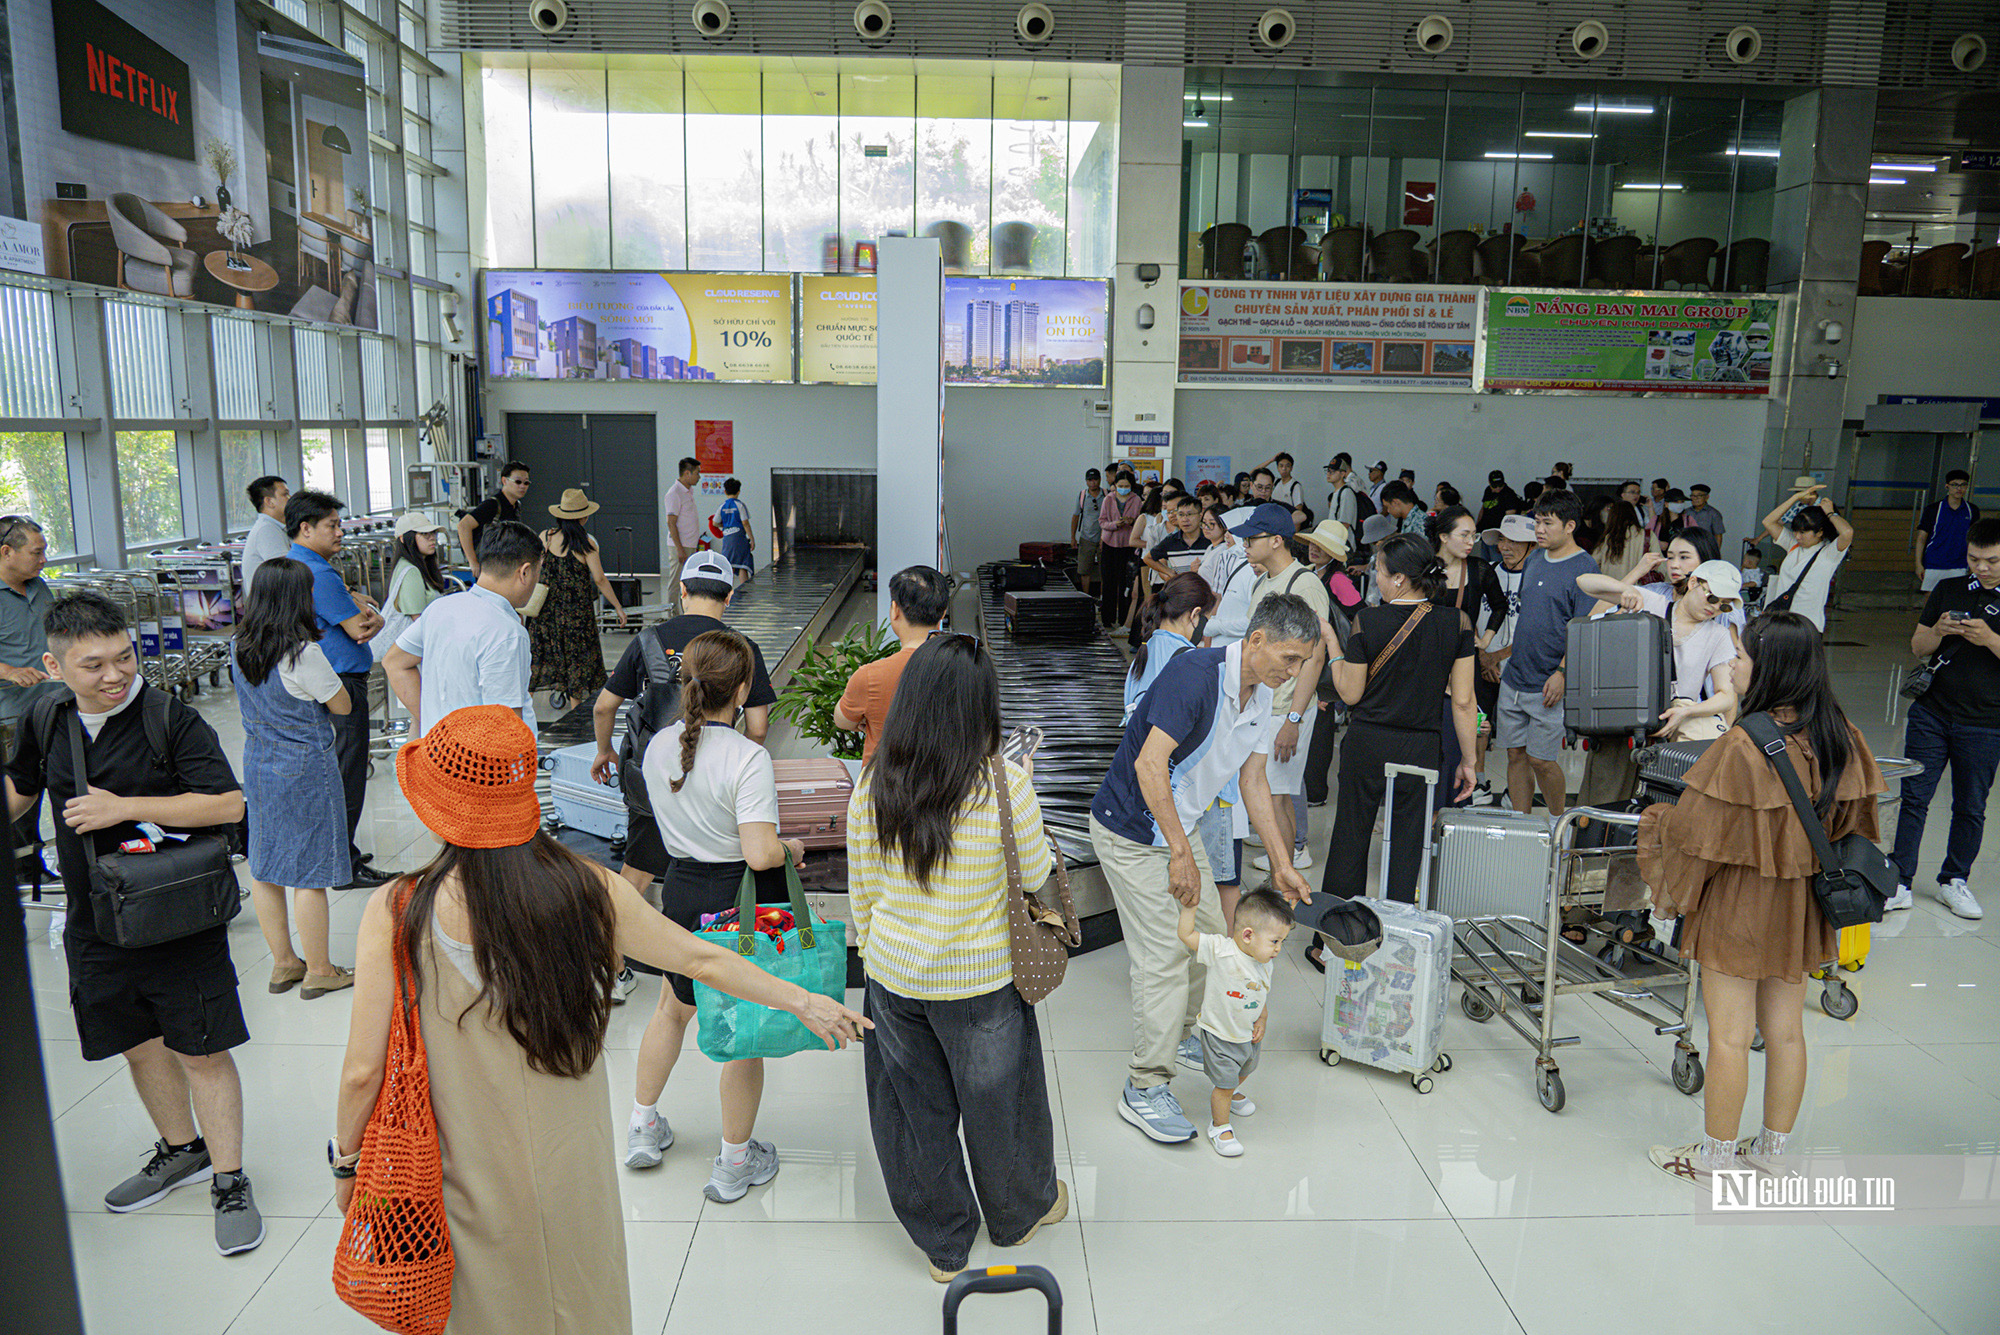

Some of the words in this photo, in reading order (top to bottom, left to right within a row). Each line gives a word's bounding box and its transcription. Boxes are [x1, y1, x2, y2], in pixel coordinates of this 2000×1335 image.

[86, 42, 179, 125] NETFLIX
[13, 243, 40, 257] AMOR
[705, 289, 736, 298] CLOUD
[737, 290, 780, 298] RESERVE
[820, 291, 860, 301] CLOUD
[1214, 288, 1246, 299] CÔNG
[1250, 290, 1263, 299] TY
[1266, 290, 1297, 300] TNHH
[1300, 289, 1322, 302] VẬT
[1325, 290, 1350, 303] LIỆU
[1354, 290, 1376, 301] XÂY
[1380, 291, 1412, 304] DỰNG
[1415, 293, 1434, 303] GIA
[1438, 292, 1476, 304] THÀNH
[568, 301, 594, 310] BIỂU
[596, 302, 634, 312] TƯỢNG
[1234, 302, 1280, 315] CHUYÊN
[1284, 302, 1308, 316] SẢN
[1347, 304, 1379, 316] PHÂN
[1382, 304, 1410, 317] PHỐI
[1413, 304, 1424, 318] SỈ
[1428, 308, 1437, 318] &
[1440, 305, 1454, 318] LẺ
[1534, 296, 1590, 315] NẮNG
[1594, 304, 1636, 316] BAN
[1640, 304, 1678, 317] MAI
[1684, 306, 1748, 318] GROUP
[600, 314, 631, 324] SỐNG
[633, 315, 654, 324] MỚI
[713, 318, 724, 326] SỞ
[726, 318, 744, 326] HỮU
[746, 317, 759, 326] CHỈ
[1046, 315, 1091, 324] LIVING
[1218, 318, 1238, 327] GẠCH
[1260, 319, 1280, 328] GẠCH
[1286, 317, 1294, 326] LỖ
[1304, 319, 1324, 328] GẠCH
[1324, 319, 1350, 328] KHÔNG
[1379, 318, 1394, 328] ỐNG
[1396, 320, 1417, 328] CỐNG
[1427, 320, 1446, 329] TÔNG
[1456, 320, 1470, 329] TÂM
[1560, 318, 1618, 327] CHUYÊN
[816, 323, 846, 332] CHUẨN
[848, 324, 866, 332] MỰC
[1046, 327, 1068, 336] ON
[1070, 328, 1096, 336] TOP
[720, 330, 772, 348] 10%
[836, 333, 859, 342] QUỐC
[860, 332, 874, 341] TẾ
[1390, 970, 1416, 991] 83
